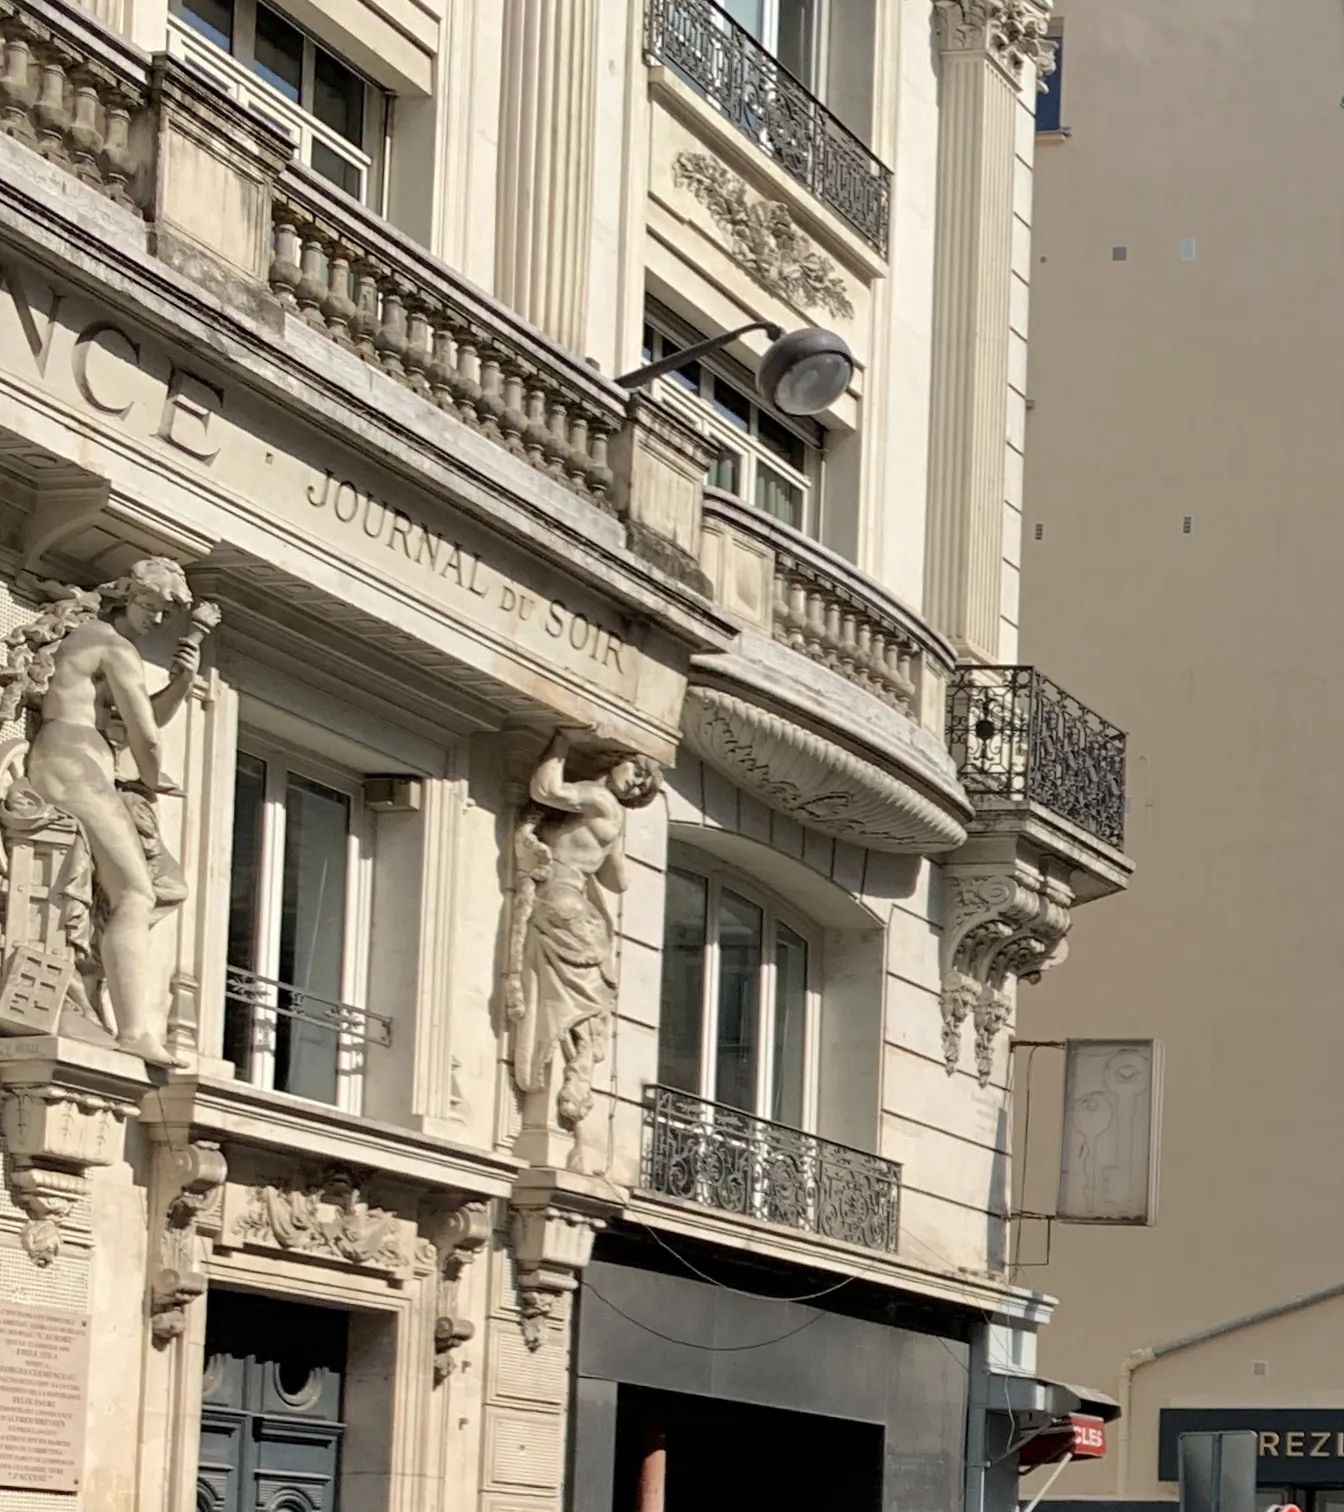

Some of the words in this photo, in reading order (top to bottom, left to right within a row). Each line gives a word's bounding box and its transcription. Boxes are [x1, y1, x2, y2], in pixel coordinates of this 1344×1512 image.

[307, 468, 489, 600] JOURNAL
[498, 584, 537, 621] DU
[544, 598, 628, 676] SOIR
